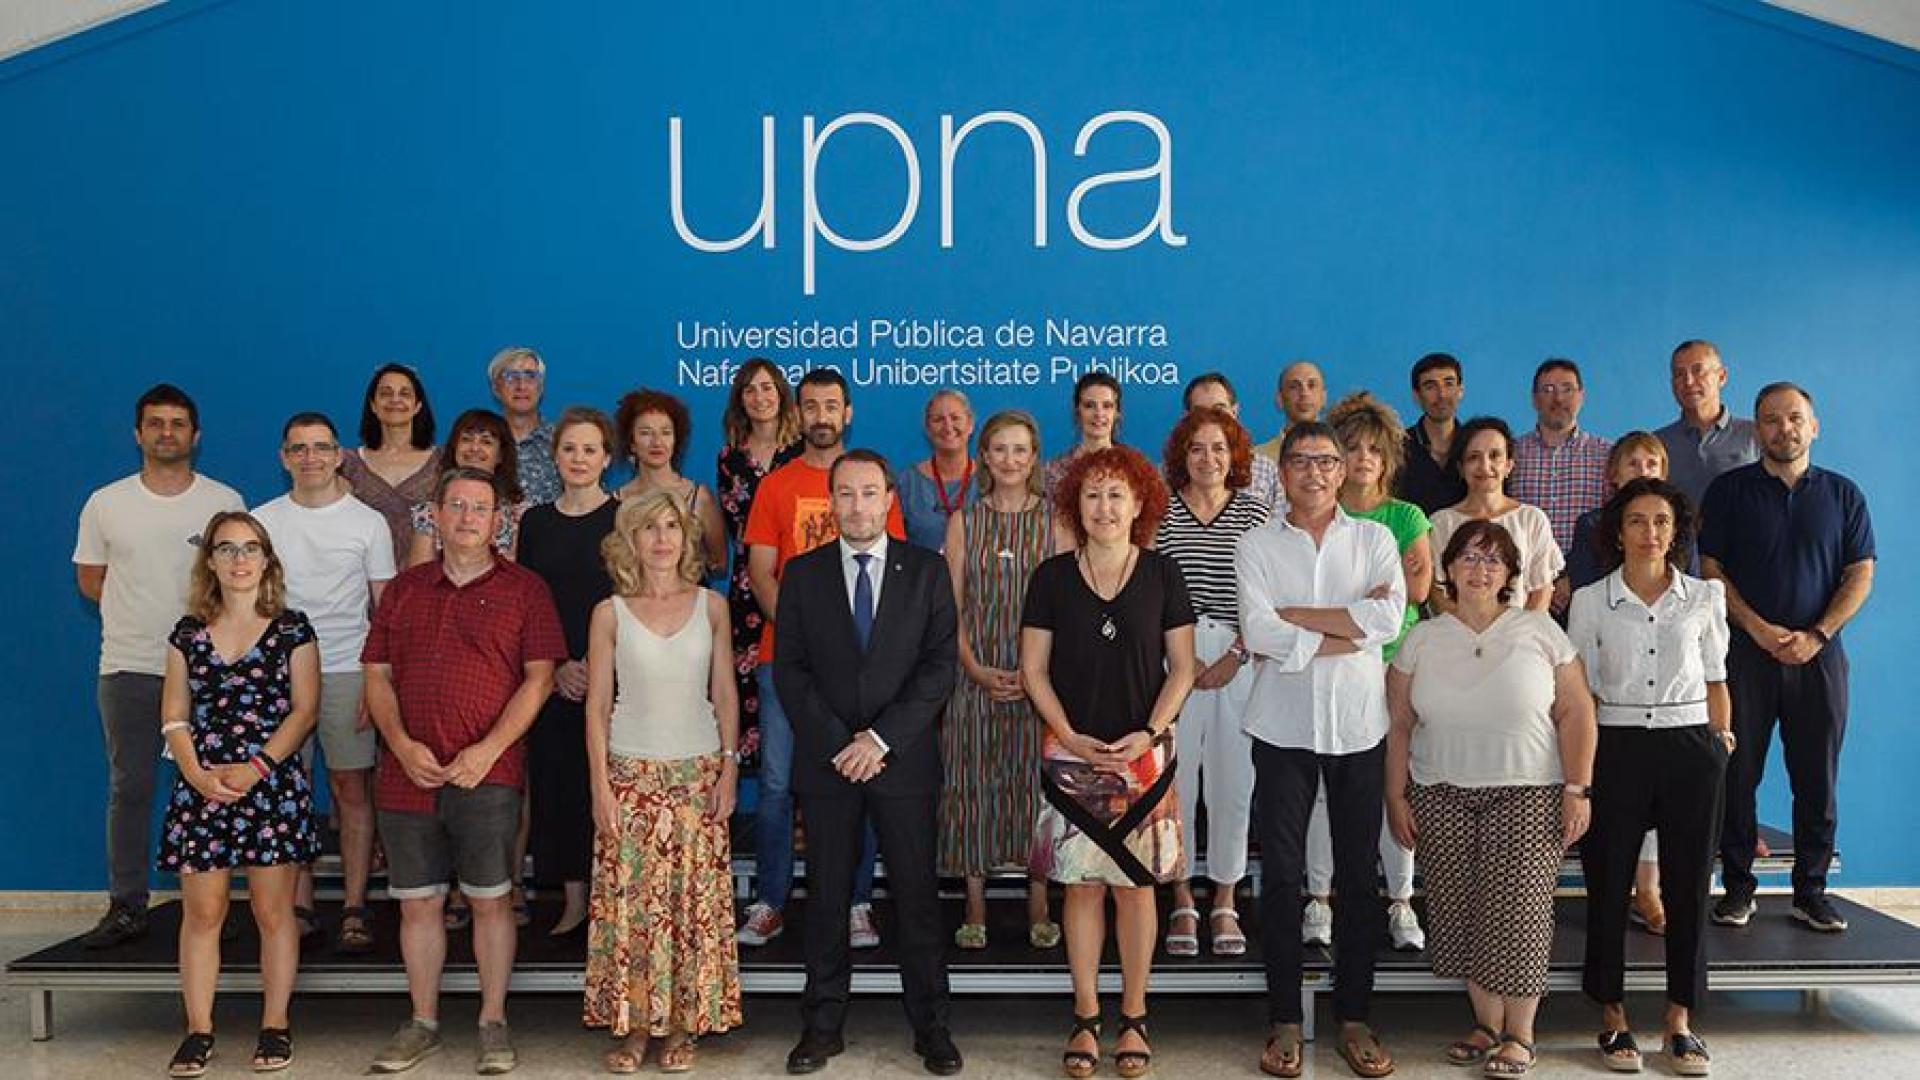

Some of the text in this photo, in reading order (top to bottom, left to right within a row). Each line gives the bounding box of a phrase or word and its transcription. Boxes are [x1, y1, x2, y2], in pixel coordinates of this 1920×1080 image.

[669, 110, 1187, 296] upna
[677, 319, 1168, 349] Universidad Pública de Navarra
[852, 357, 1042, 385] Unibertsitate
